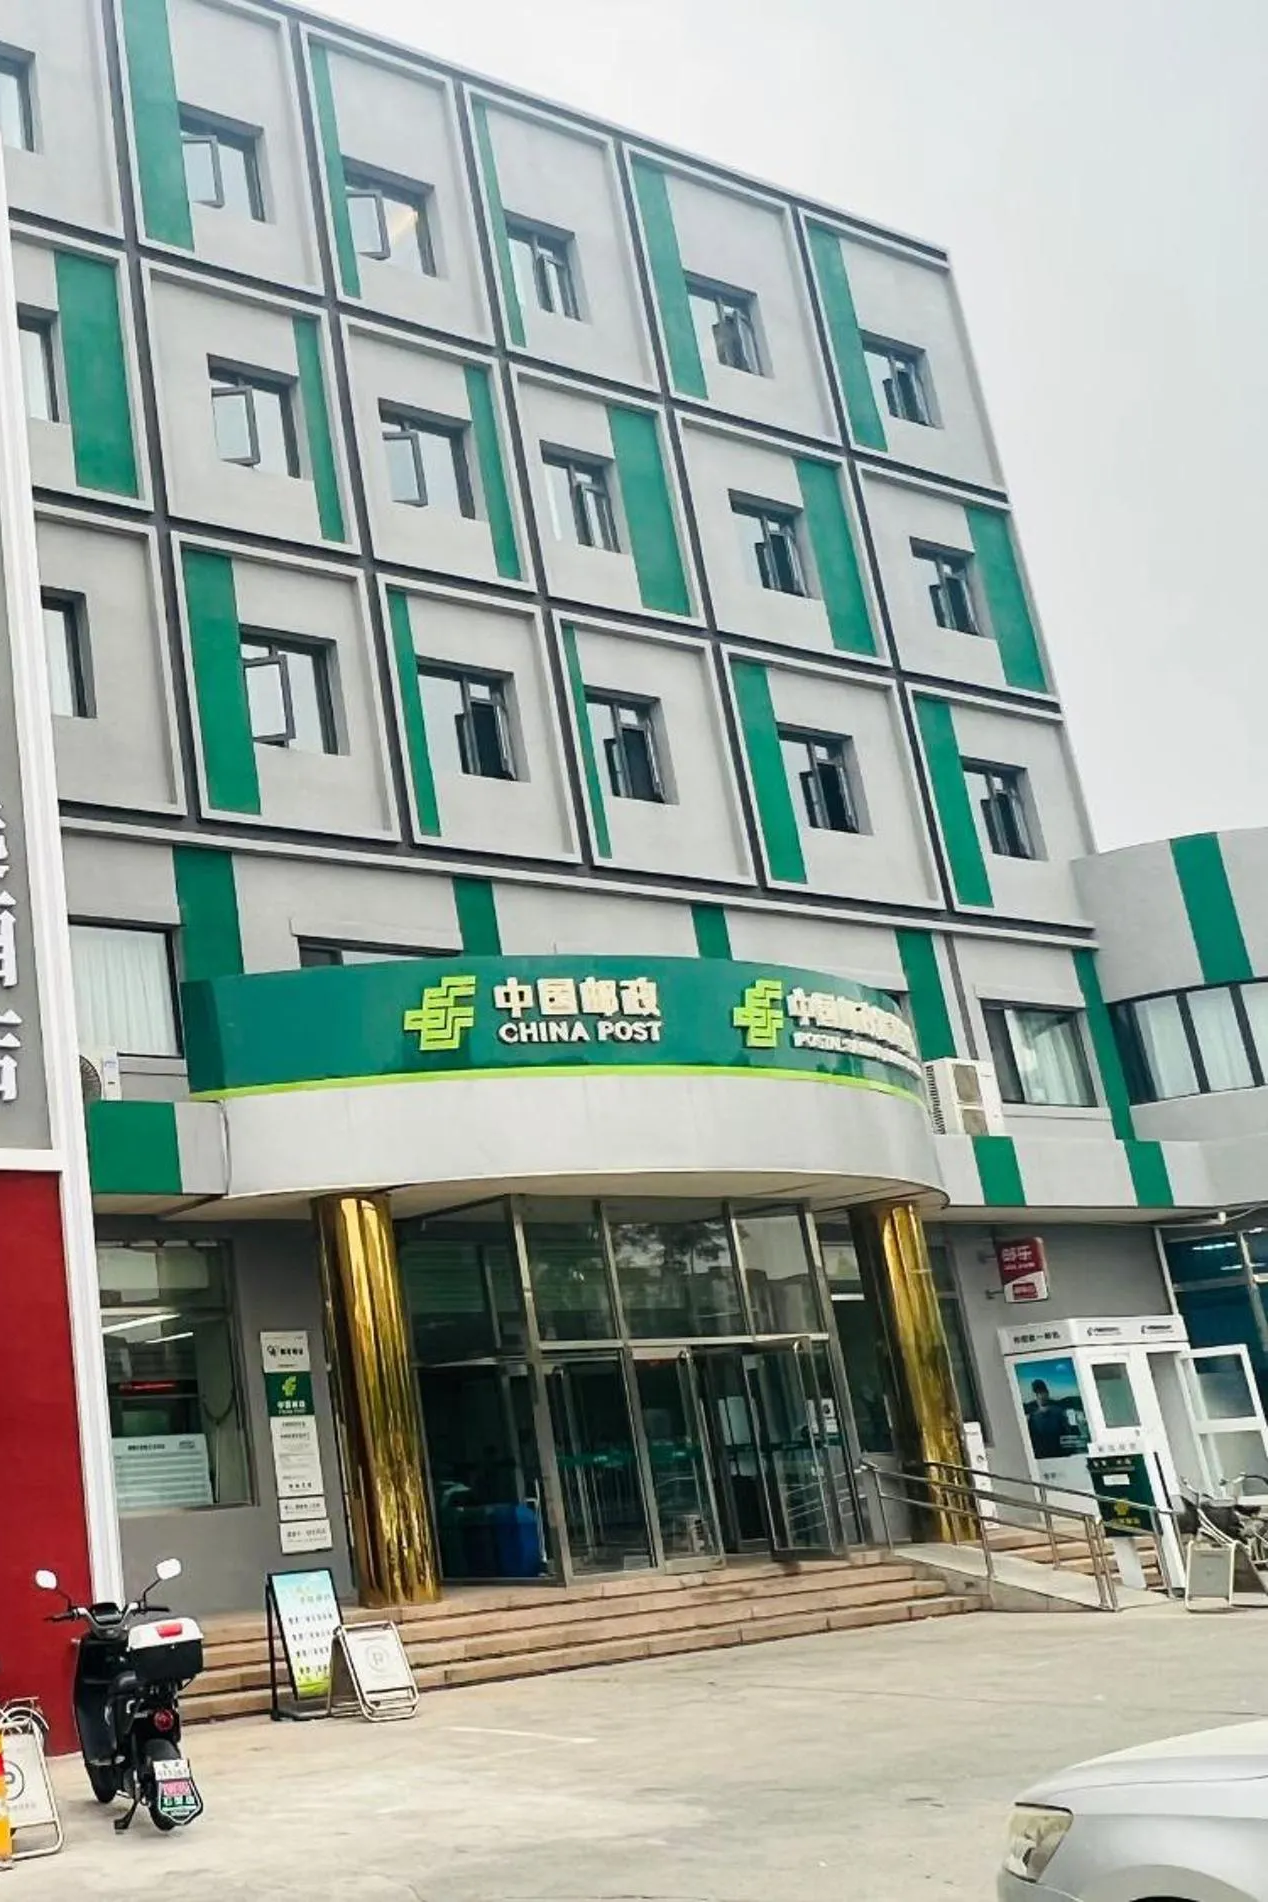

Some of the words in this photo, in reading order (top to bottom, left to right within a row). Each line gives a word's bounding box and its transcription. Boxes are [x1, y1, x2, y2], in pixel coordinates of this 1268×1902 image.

[493, 976, 662, 1019] 中国邮政
[498, 1020, 591, 1044] CHINA
[597, 1019, 664, 1042] POST
